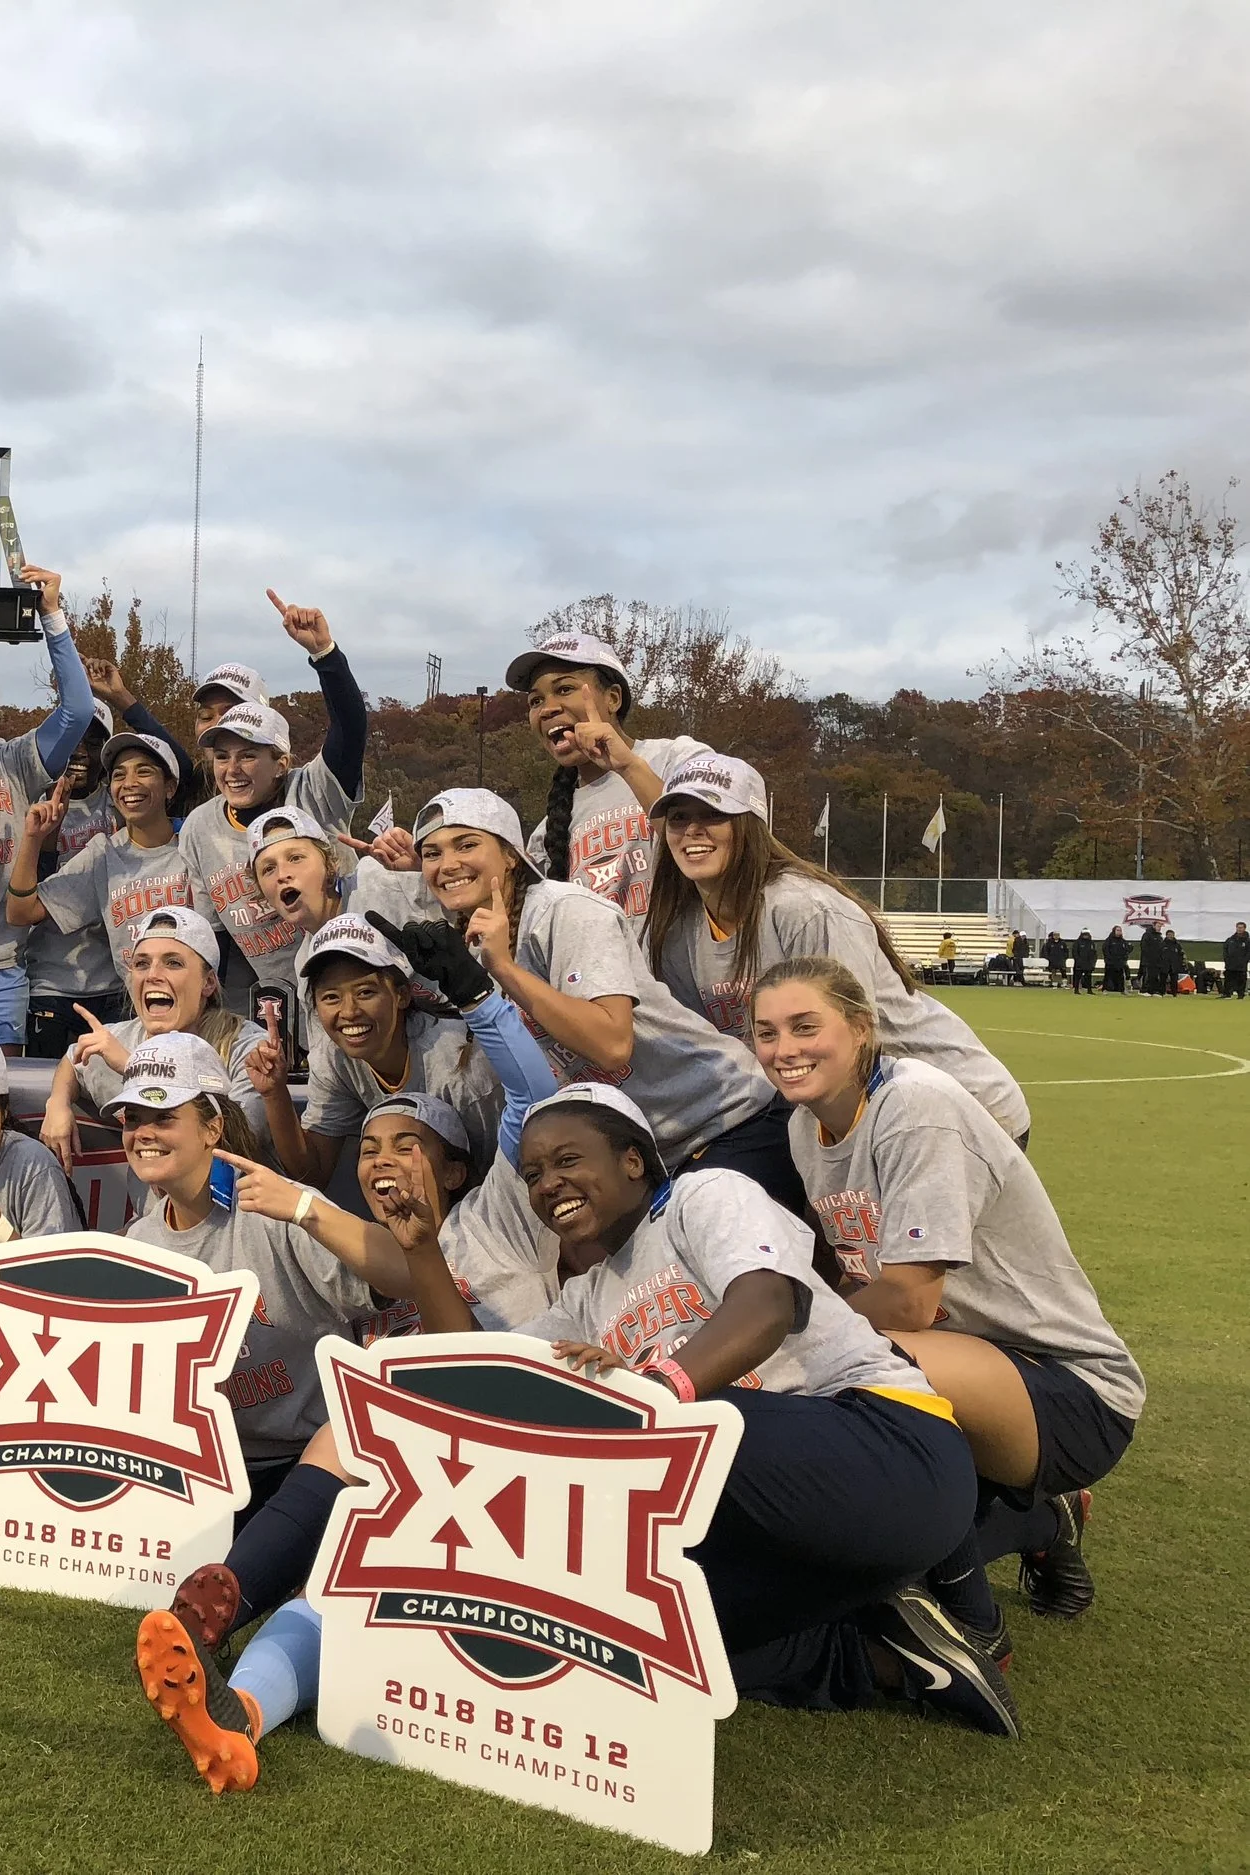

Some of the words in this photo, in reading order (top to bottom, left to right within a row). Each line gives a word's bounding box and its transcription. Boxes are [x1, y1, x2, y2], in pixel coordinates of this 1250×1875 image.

[667, 771, 732, 791] CHAMPIONS
[584, 804, 644, 832] CONFEREN
[624, 848, 648, 875] 18
[111, 885, 127, 899] BIG
[131, 880, 141, 890] 12
[210, 869, 225, 885] BIG
[110, 884, 194, 928] SOCC
[210, 872, 255, 913] SOC
[230, 908, 251, 927] 20
[329, 917, 356, 929] XII
[1126, 901, 1169, 922] XII
[313, 928, 375, 953] CHAMPIONS
[134, 1048, 158, 1063] XII
[1, 1448, 164, 1481] CHAMPIONSHIP
[360, 1401, 672, 1642] XII
[71, 1528, 123, 1553] BIG
[139, 1537, 173, 1561] 12
[59, 1557, 177, 1587] CHAMPIONS
[402, 1598, 616, 1665] CHAMPIONSHIP
[384, 1679, 476, 1725] 2018
[494, 1708, 564, 1750] BIG
[584, 1734, 629, 1769] 12
[376, 1713, 468, 1755] SOCCER
[480, 1743, 636, 1804] CHAMPIONS
